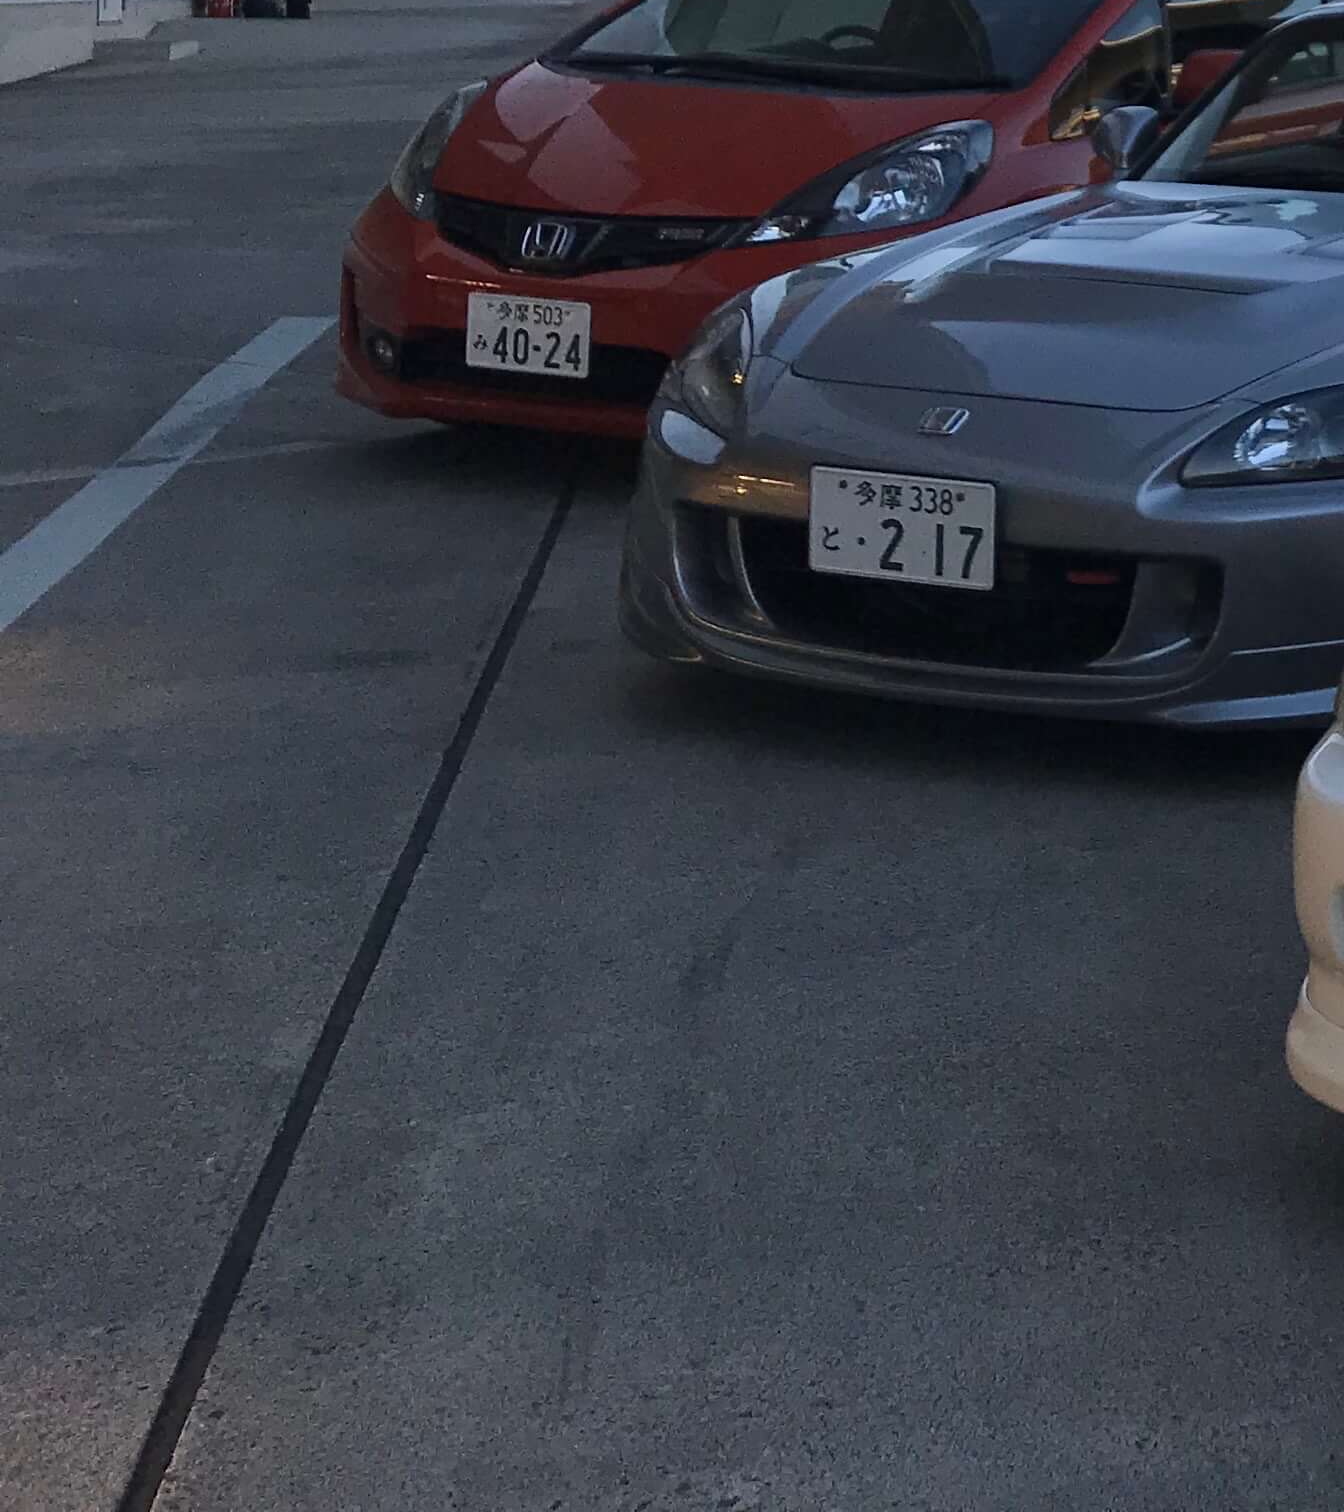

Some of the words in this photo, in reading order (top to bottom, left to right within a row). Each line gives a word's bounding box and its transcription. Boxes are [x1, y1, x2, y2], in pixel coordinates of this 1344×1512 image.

[533, 304, 562, 326] 503
[493, 326, 581, 371] 40-24
[854, 481, 903, 510] 多摩
[909, 486, 953, 516] 338
